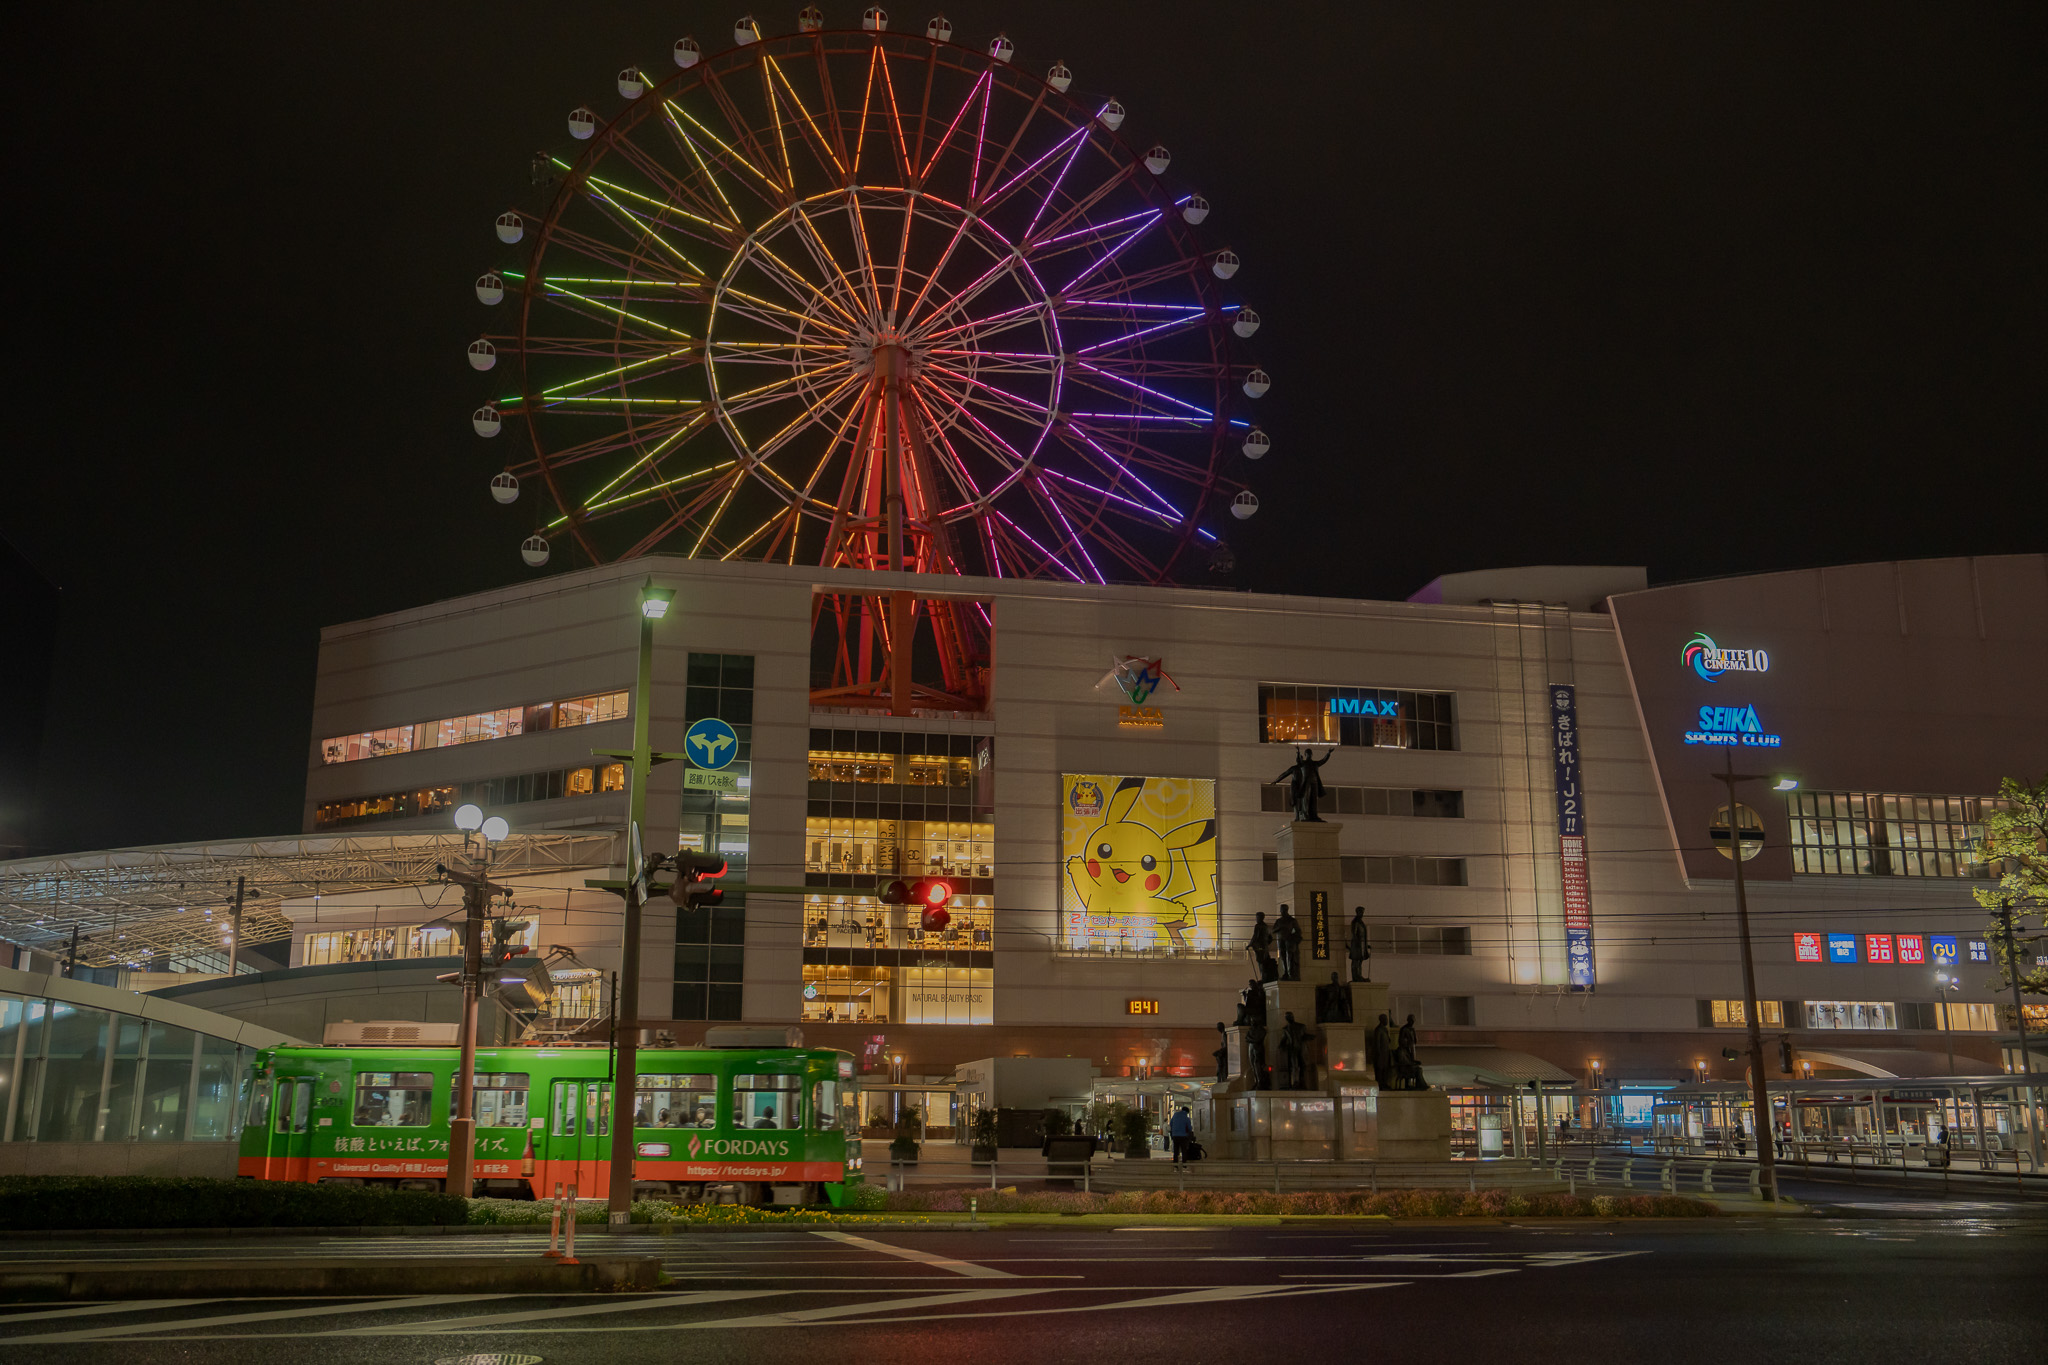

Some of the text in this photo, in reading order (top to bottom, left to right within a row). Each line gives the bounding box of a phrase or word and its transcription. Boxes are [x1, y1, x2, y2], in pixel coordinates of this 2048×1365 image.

[1703, 648, 1770, 673] MITTE 10
[1704, 660, 1746, 671] CINEMA
[1119, 705, 1164, 720] PLAZA
[1330, 698, 1398, 716] IMAX
[1698, 703, 1764, 733] SEIKA
[1684, 731, 1782, 748] SPORTS CLUB
[688, 773, 735, 788] 路線バスを除く
[1562, 839, 1583, 848] HOME
[1869, 937, 1889, 948] ユニ
[1899, 938, 1919, 949] UNI
[1968, 941, 1986, 951] 無印
[1870, 949, 1890, 960] クロ
[1901, 949, 1921, 962] QLO
[1933, 943, 1956, 957] GU
[1970, 951, 1988, 961] 良品
[912, 993, 983, 1004] NATURAL BEAUTY BASIC
[704, 1139, 789, 1156] FORDAYS
[333, 1163, 370, 1172] Universal
[687, 1165, 787, 1177] https://fordays.jp/
